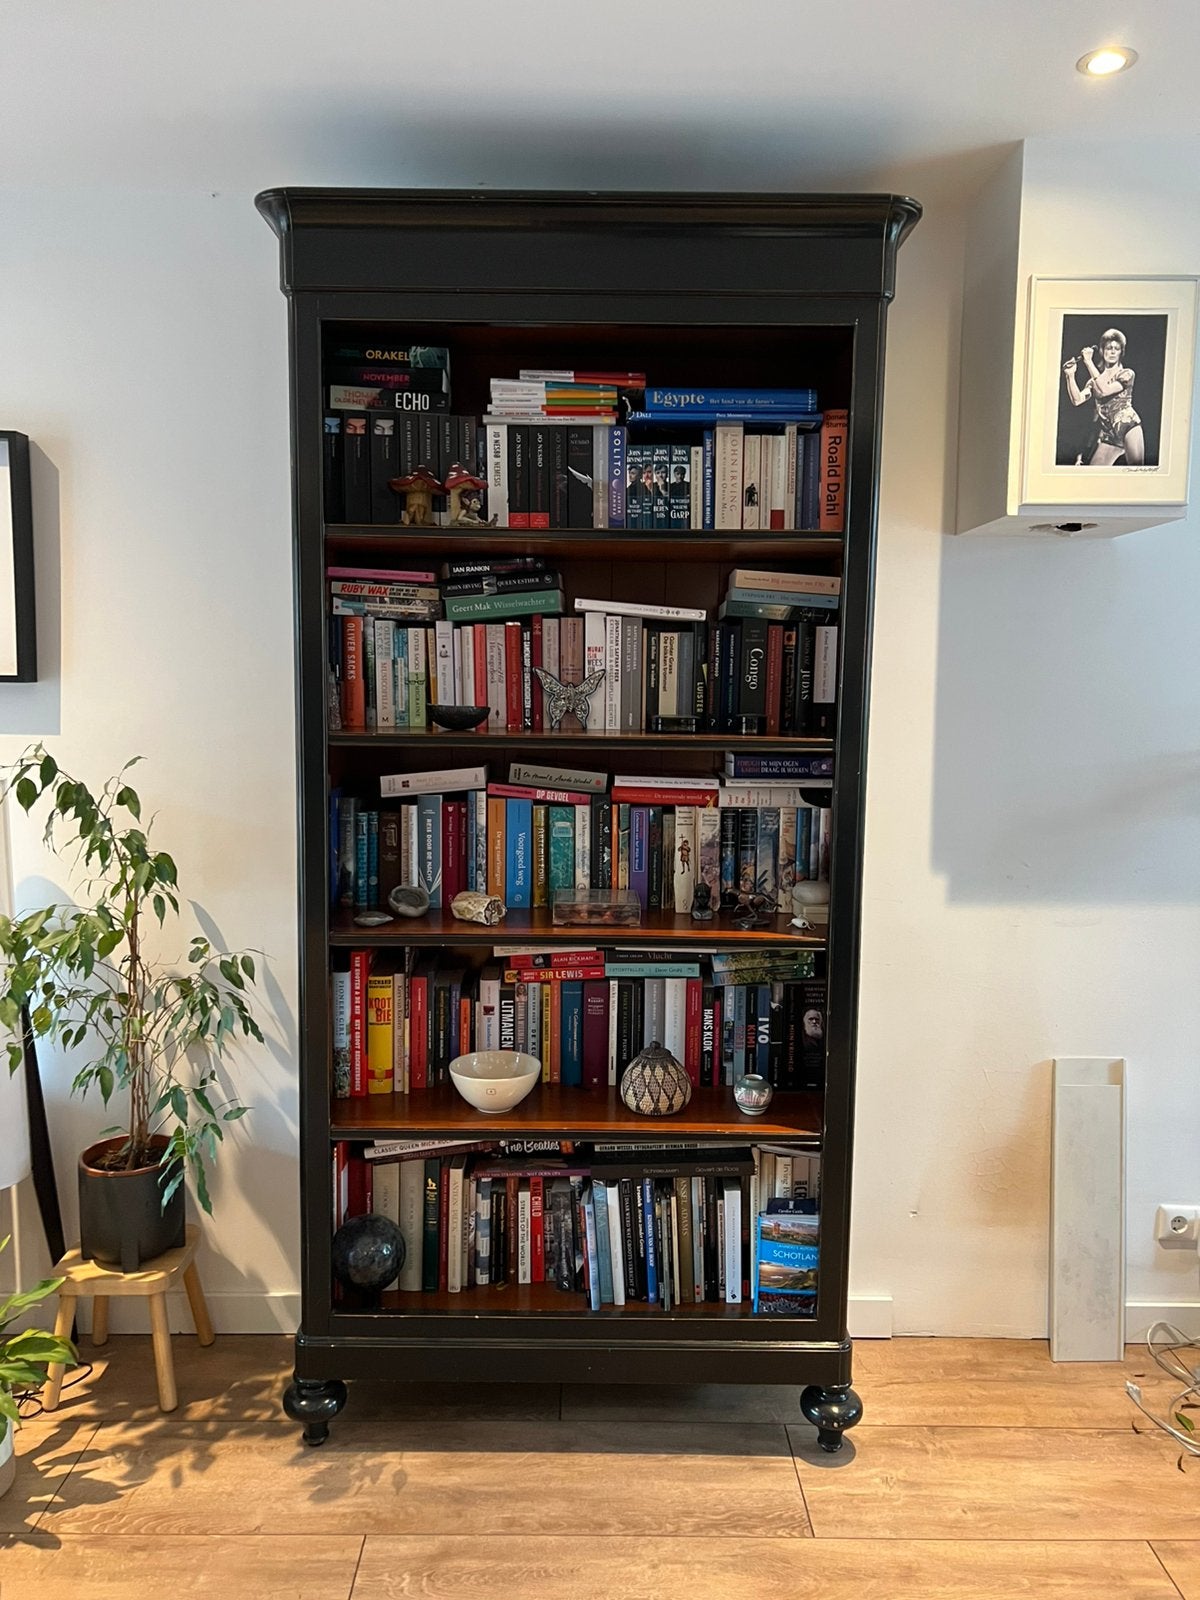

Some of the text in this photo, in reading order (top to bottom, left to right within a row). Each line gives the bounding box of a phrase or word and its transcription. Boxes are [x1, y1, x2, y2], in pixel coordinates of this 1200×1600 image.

[365, 350, 410, 361] ORAKEL
[362, 373, 410, 383] NOVEMBER
[395, 391, 430, 411] ECHO
[652, 390, 705, 407] Egypte
[515, 432, 522, 442] JO
[537, 432, 543, 442] JO
[555, 432, 562, 443] JO
[613, 430, 621, 476] SOLITO
[674, 447, 687, 455] JOHN
[493, 461, 501, 487] NEMESIS
[729, 432, 738, 512] JOHN IRVING
[826, 435, 842, 516] Roald Dahl
[670, 510, 690, 519] GARP
[465, 565, 490, 573] RANKIN
[340, 583, 389, 596] RUBY WAX
[452, 597, 545, 613] Geert Mak Wisselwachter
[383, 626, 391, 657] OLIVER
[662, 636, 669, 644] De
[347, 623, 355, 680] OLIVER SACKS
[744, 648, 764, 690] Congo
[800, 669, 810, 700] JUDAS
[696, 682, 704, 713] LUISTER
[536, 789, 545, 799] OP
[546, 790, 569, 802] GEVOEL
[426, 851, 432, 860] DE
[516, 832, 526, 886] Voorgoed weg
[537, 828, 545, 886] ARTEMIS FOWL
[647, 951, 672, 960] Vlucht
[539, 971, 554, 979] SIR
[555, 970, 583, 978] LEWIS
[369, 997, 392, 1009] KOOT
[501, 1000, 514, 1048] LITMANEN
[703, 1009, 713, 1052] HANS KLOK
[758, 1017, 769, 1044] IVO
[531, 1029, 537, 1037] DE
[747, 1024, 756, 1048] KIMI
[374, 1146, 397, 1155] CLASSIC
[399, 1143, 420, 1151] QUEEN
[523, 1140, 560, 1153] Beatles
[597, 1192, 606, 1229] AFRIKA
[773, 1250, 818, 1261] SCHOTLAN
